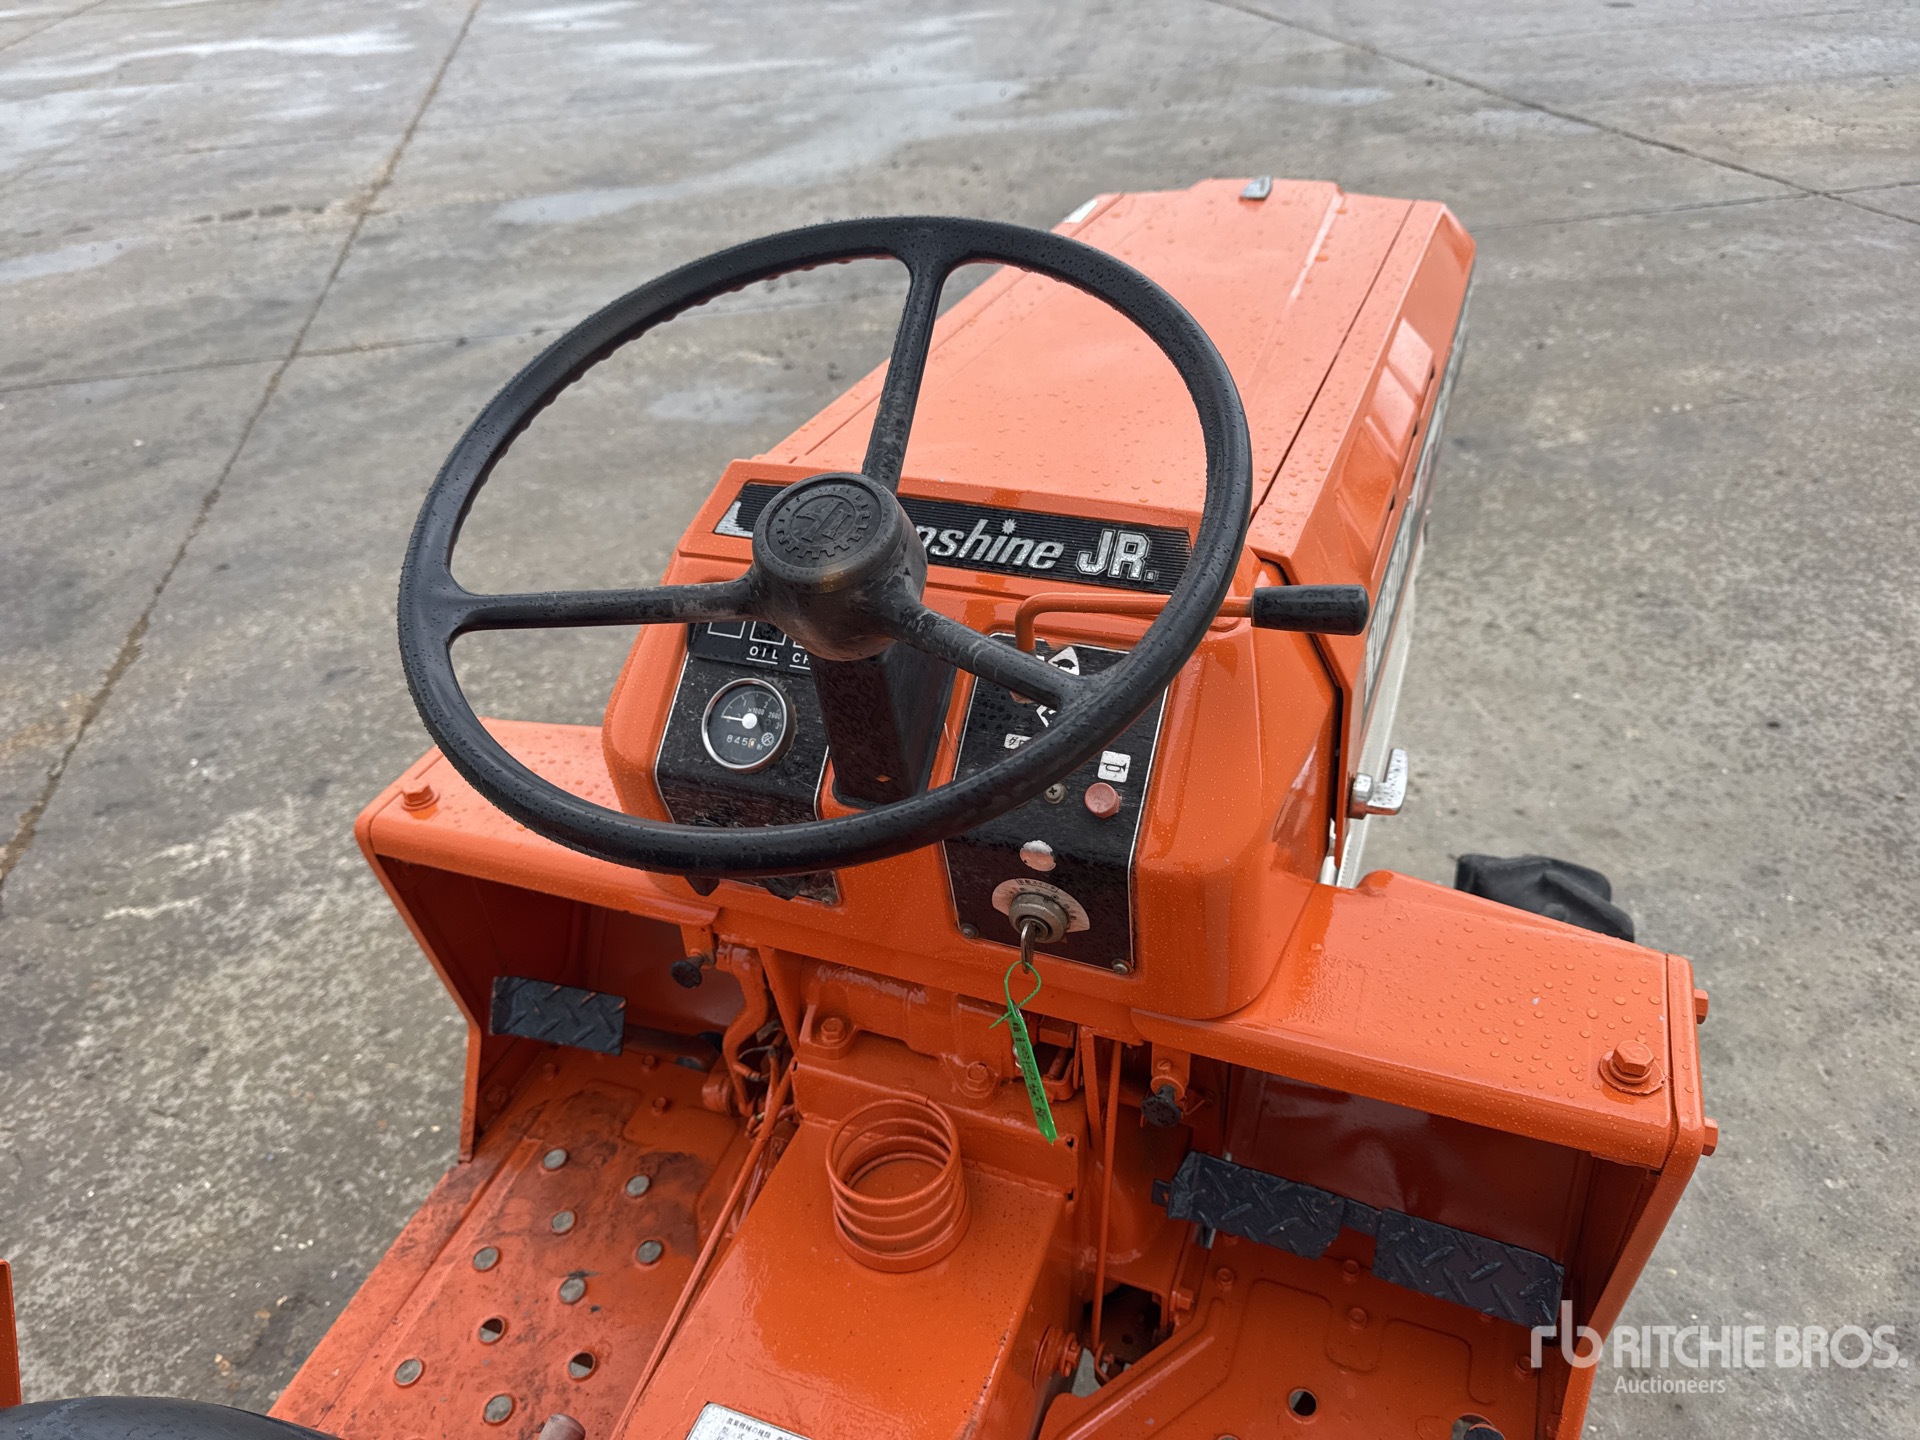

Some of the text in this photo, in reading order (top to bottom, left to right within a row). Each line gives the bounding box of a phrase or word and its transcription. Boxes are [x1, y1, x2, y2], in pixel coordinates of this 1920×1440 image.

[915, 518, 1064, 570] nshine
[749, 645, 778, 660] OIL
[792, 652, 810, 665] CH
